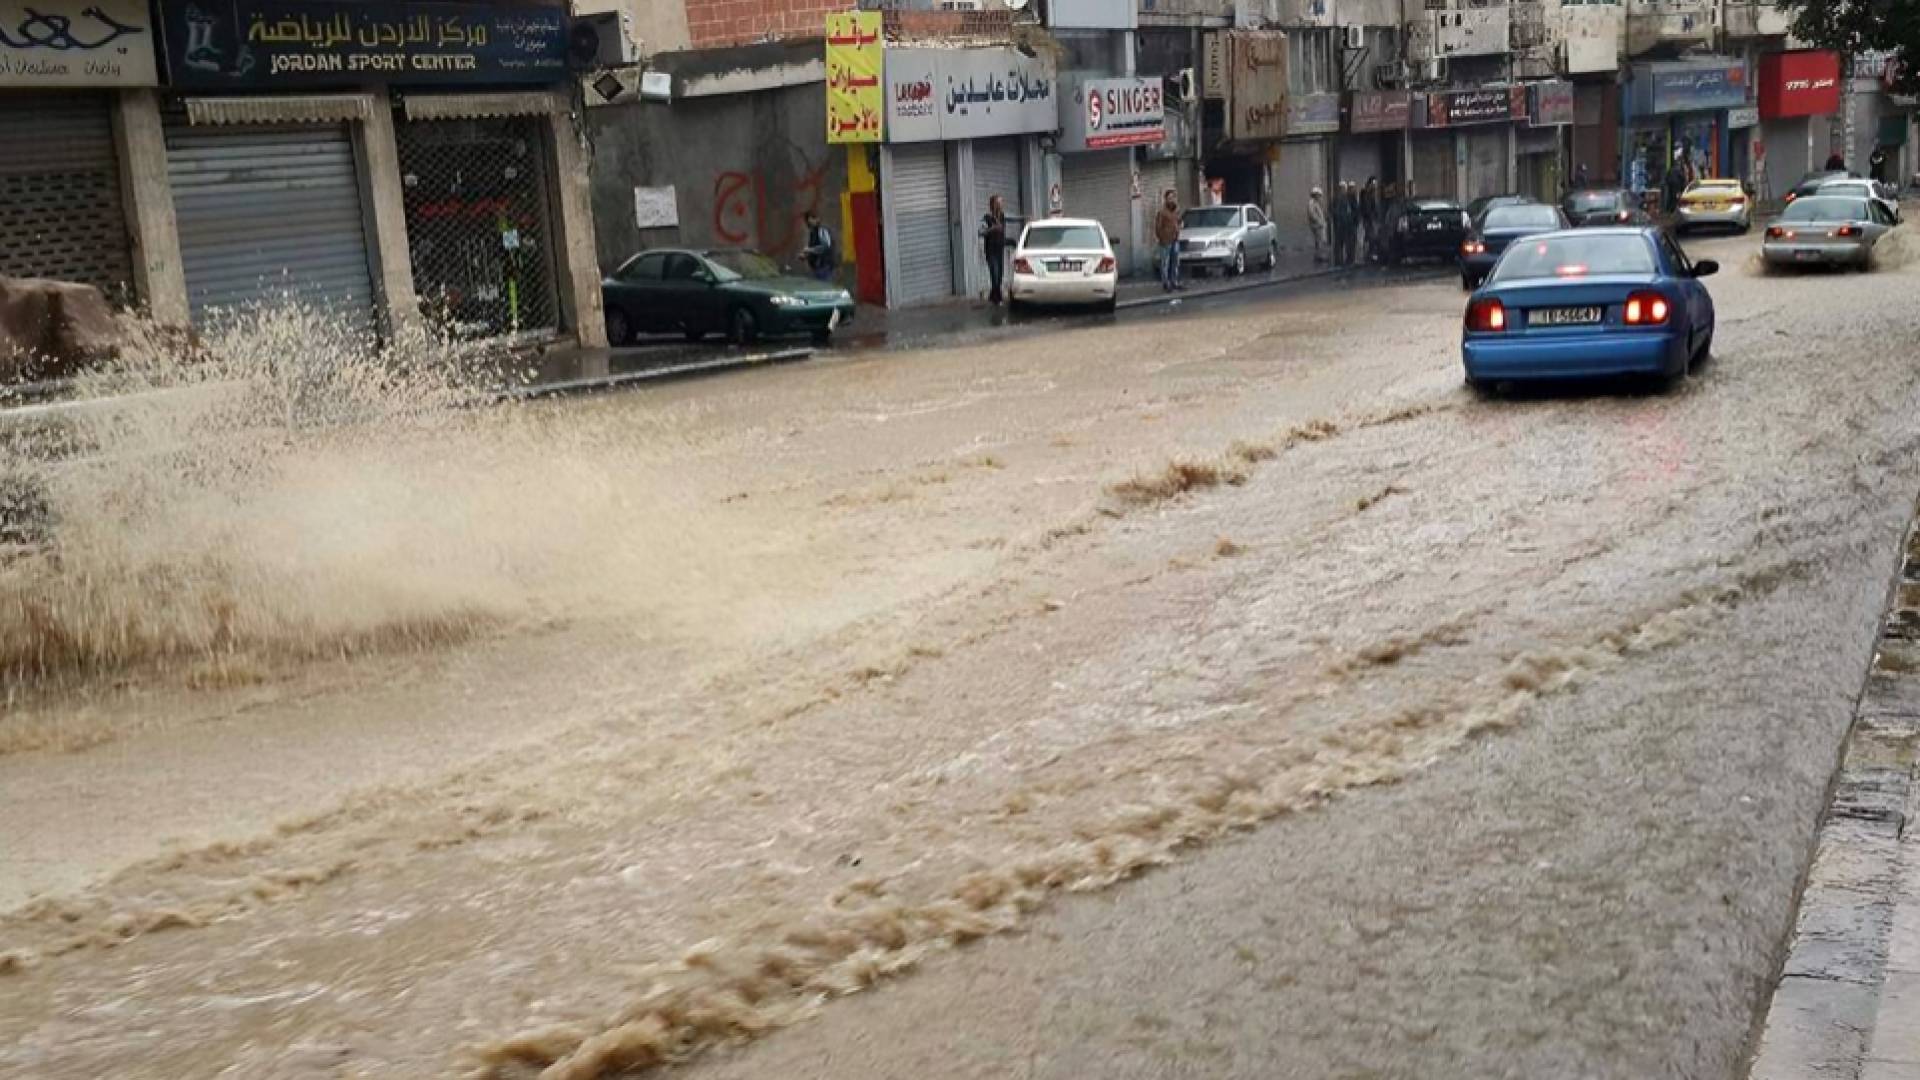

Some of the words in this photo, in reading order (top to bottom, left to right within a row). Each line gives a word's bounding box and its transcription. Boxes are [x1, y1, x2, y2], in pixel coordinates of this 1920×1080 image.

[248, 11, 353, 48] للرياضة
[436, 15, 488, 49] مركز
[270, 53, 342, 74] JORDAN
[346, 53, 406, 71] SPORT
[412, 53, 477, 71] CENTER
[1107, 87, 1160, 115] SINGER
